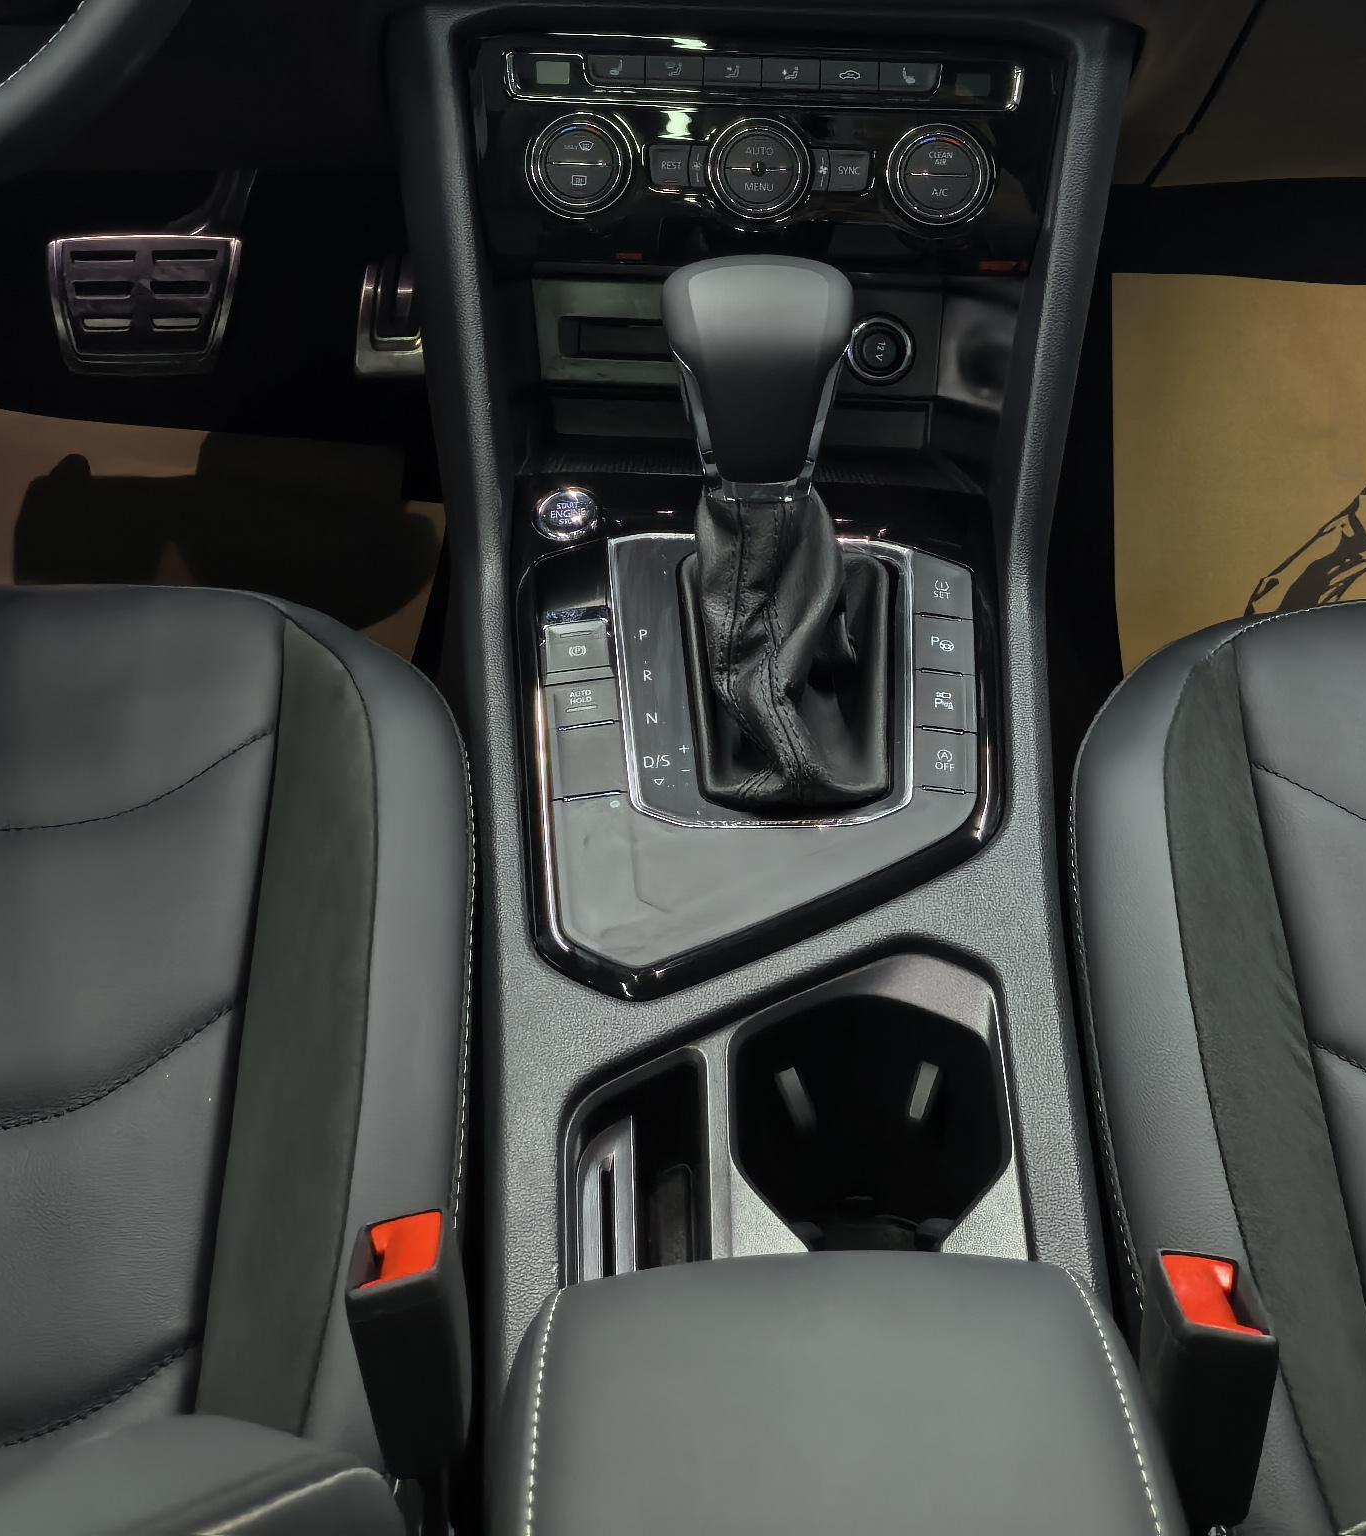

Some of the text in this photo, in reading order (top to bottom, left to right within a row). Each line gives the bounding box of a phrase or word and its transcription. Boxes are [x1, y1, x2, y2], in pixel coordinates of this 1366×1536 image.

[745, 146, 774, 157] AUTO
[928, 150, 954, 160] CLEAN
[660, 160, 682, 171] REST
[837, 165, 861, 176] SYNC
[744, 181, 775, 192] MENU
[931, 187, 948, 198] A/C
[933, 590, 951, 600] SET
[639, 629, 648, 641] P
[643, 669, 653, 682] R
[569, 689, 592, 699] AUTO
[570, 695, 592, 705] HOLD
[645, 712, 658, 725] N
[643, 754, 671, 769] D/S
[934, 761, 955, 773] OFF
